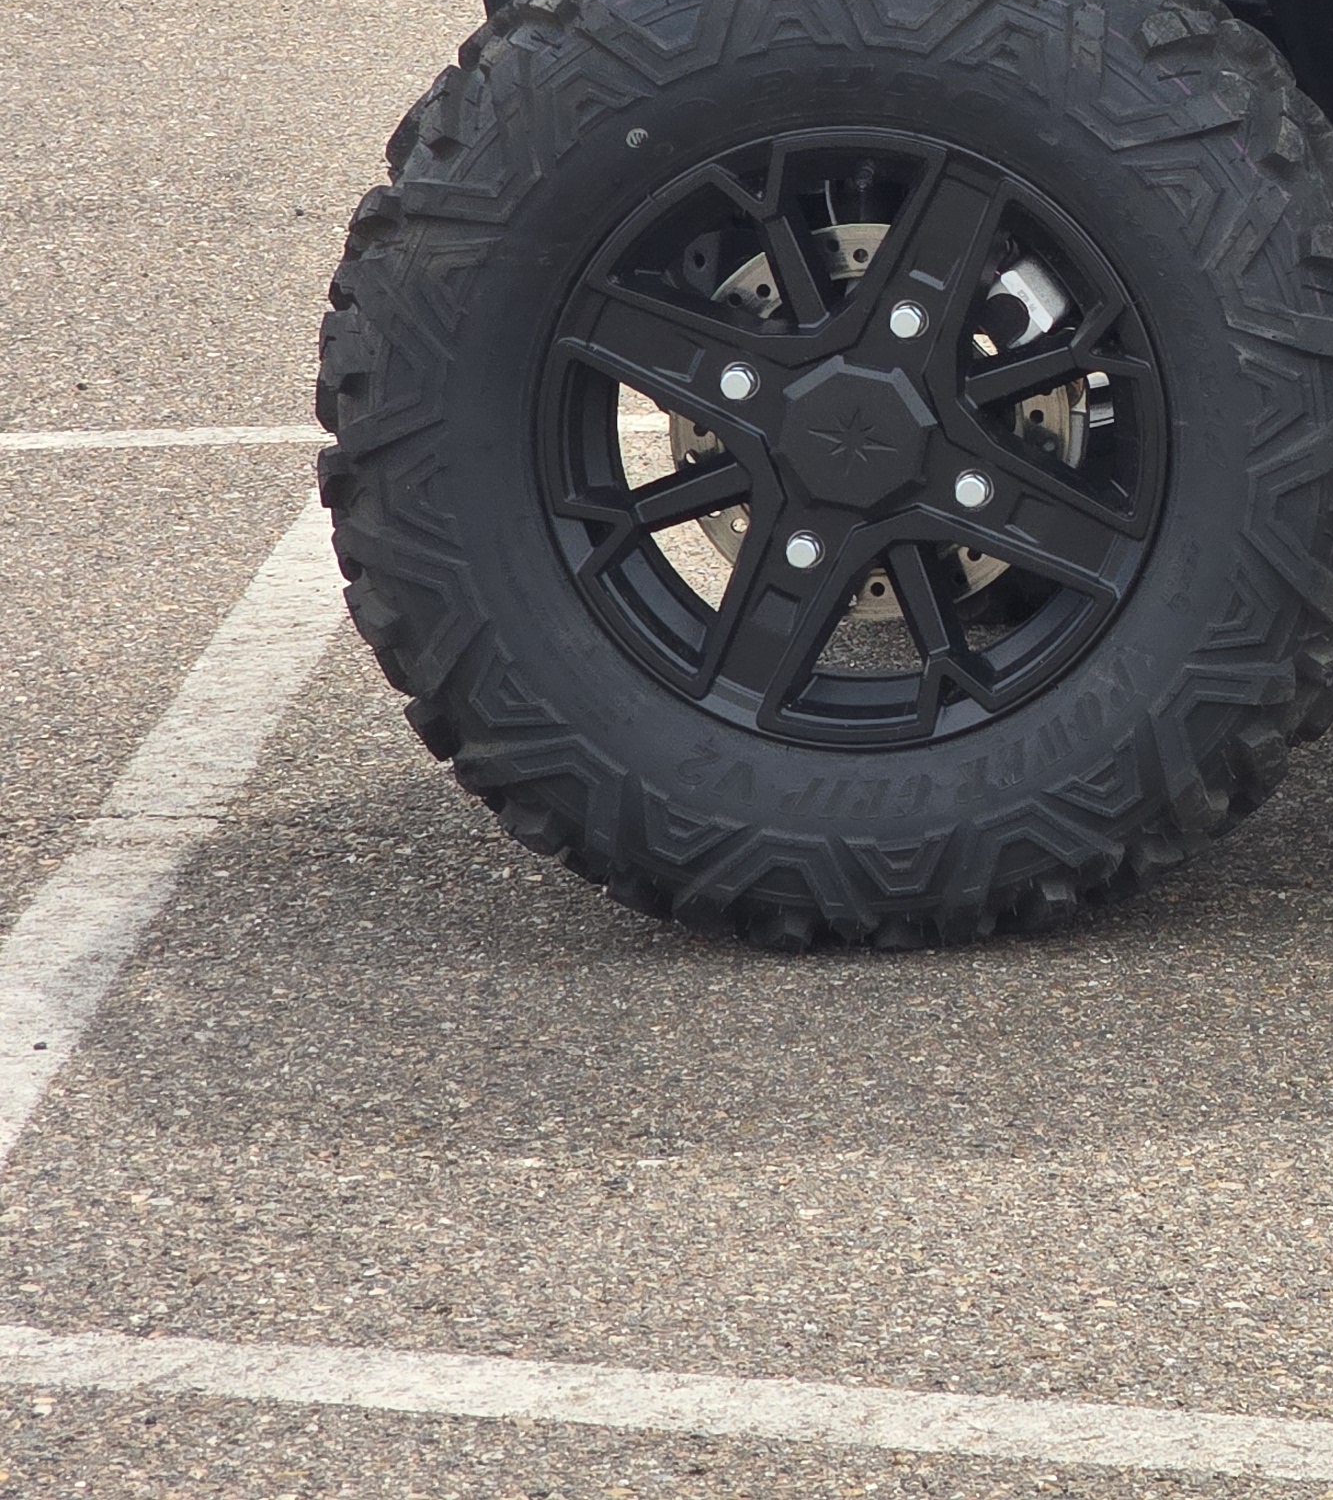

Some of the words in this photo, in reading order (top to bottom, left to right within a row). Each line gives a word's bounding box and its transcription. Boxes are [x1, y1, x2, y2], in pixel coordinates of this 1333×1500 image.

[952, 657, 1143, 803] POWER
[673, 739, 763, 808] V2
[775, 771, 939, 820] GRIP
